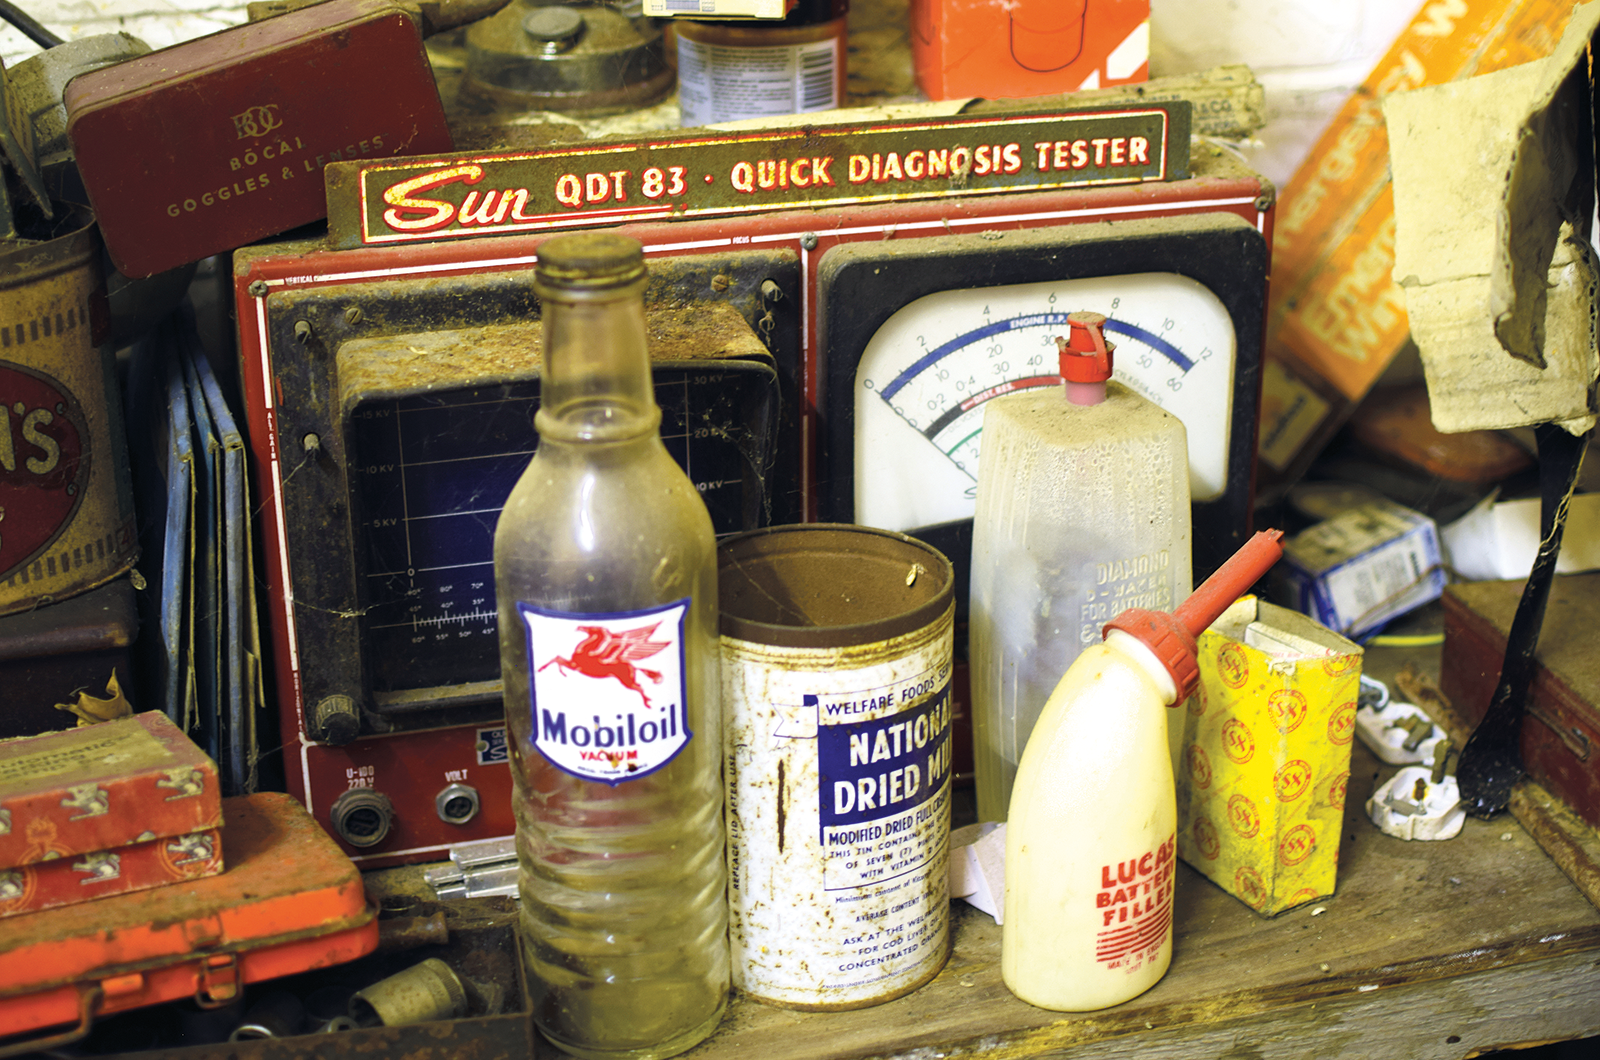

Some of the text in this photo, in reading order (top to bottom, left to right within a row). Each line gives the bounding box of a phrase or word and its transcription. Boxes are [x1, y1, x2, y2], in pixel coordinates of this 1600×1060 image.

[167, 134, 385, 218] GOGGLES & LENSES
[382, 134, 1152, 234] Sun QDT 83 QUICK DIAGNOSIS TESTER
[732, 235, 750, 245] FOCUS
[1009, 314, 1046, 330] ENGINE
[863, 292, 1214, 390] 0 2 4 6 8 10 12
[934, 368, 950, 384] 10
[986, 343, 1004, 359] 20
[1040, 334, 1057, 347] 30
[1135, 353, 1153, 370] 50
[1166, 377, 1184, 393] 60
[993, 360, 1011, 375] 30
[1026, 354, 1044, 367] 40
[693, 375, 707, 385] 30
[376, 409, 391, 418] KV
[694, 428, 709, 438] 20
[379, 464, 395, 474] KV
[708, 480, 723, 490] KV
[382, 518, 398, 527] KV
[1096, 549, 1170, 585] DIAMOND
[1081, 602, 1107, 622] FOR
[825, 693, 894, 716] WELFARE
[901, 676, 935, 703] FOODS
[541, 703, 677, 748] Mobiloil
[444, 769, 469, 782] VOLT
[833, 735, 951, 816] DRIED MIL
[828, 824, 883, 847] MODIFIED
[884, 816, 914, 838] DRIED
[915, 807, 933, 828] FULL
[829, 850, 851, 859] THIS
[856, 845, 873, 856] TIN
[845, 861, 859, 870] OF
[866, 853, 893, 867] SEVEN
[899, 846, 912, 859] (7)
[1101, 831, 1176, 889] LUCAS
[859, 867, 884, 880] WITH
[890, 852, 924, 872] VITAMIN
[834, 892, 873, 904] Minimum
[855, 897, 920, 923] AVERAGE CONTENT
[843, 936, 863, 946] ASK
[867, 931, 881, 943] AT
[885, 924, 904, 938] THE
[858, 944, 880, 956] FOR
[882, 936, 904, 951] COD
[906, 924, 929, 942] LIVER
[838, 943, 919, 972] CONCENTRATED
